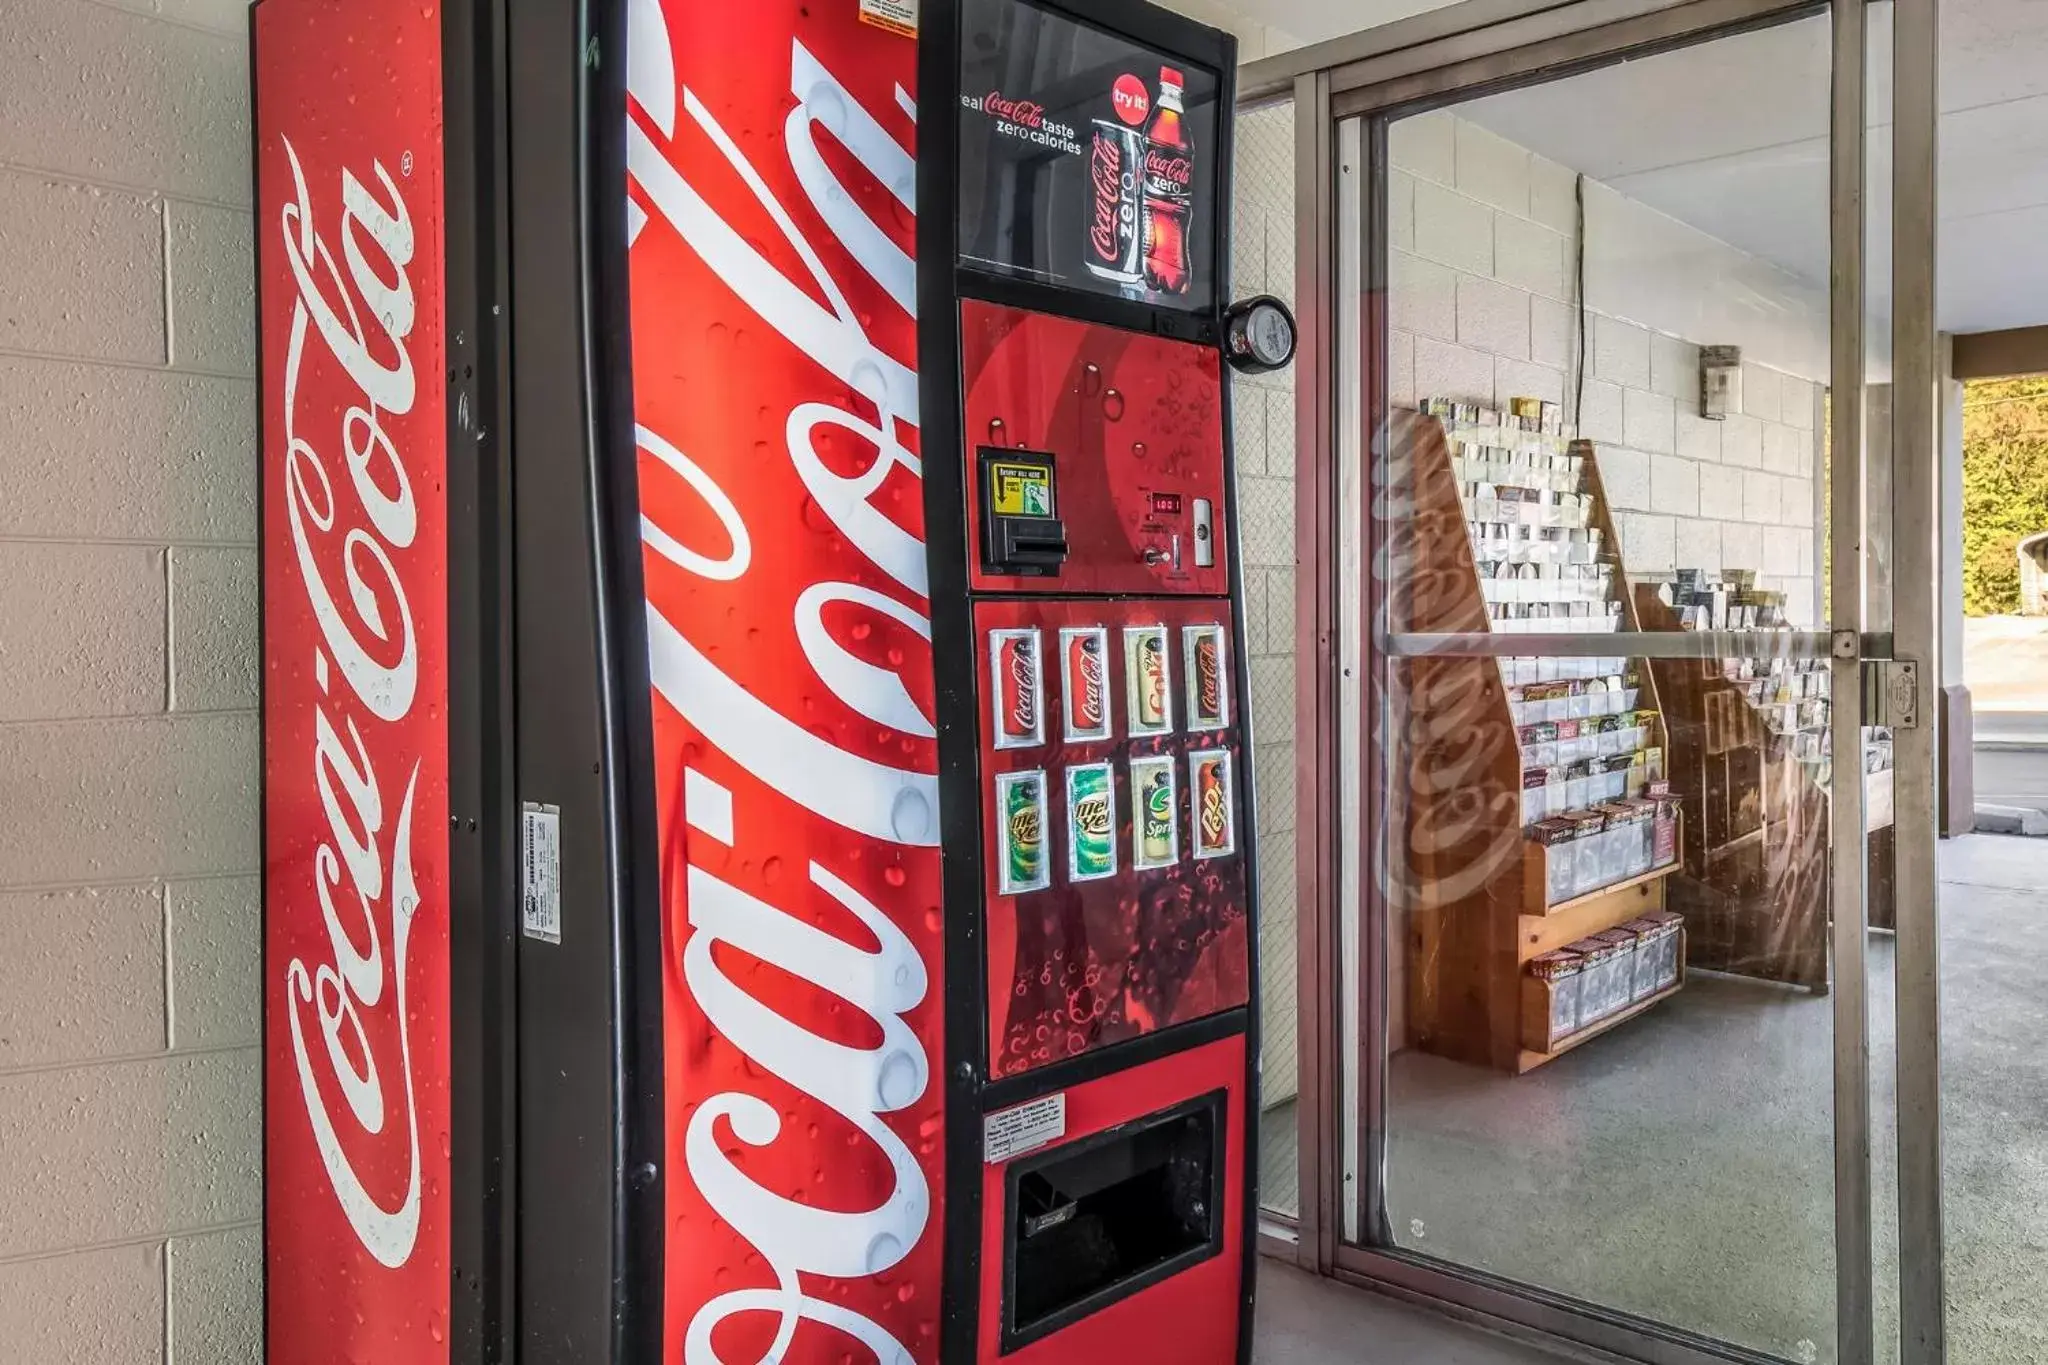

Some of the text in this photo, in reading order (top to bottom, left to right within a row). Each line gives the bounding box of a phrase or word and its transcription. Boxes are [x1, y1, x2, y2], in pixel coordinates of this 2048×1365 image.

[959, 90, 1075, 139] eal Coca-Cola taste
[1113, 88, 1133, 109] try
[996, 119, 1082, 155] zero calories
[1145, 149, 1192, 184] Coca-Cola
[1152, 176, 1181, 194] zero
[1090, 131, 1120, 262] Coca-Cola
[1120, 172, 1134, 239] zero
[284, 132, 422, 1268] Coca-Cola
